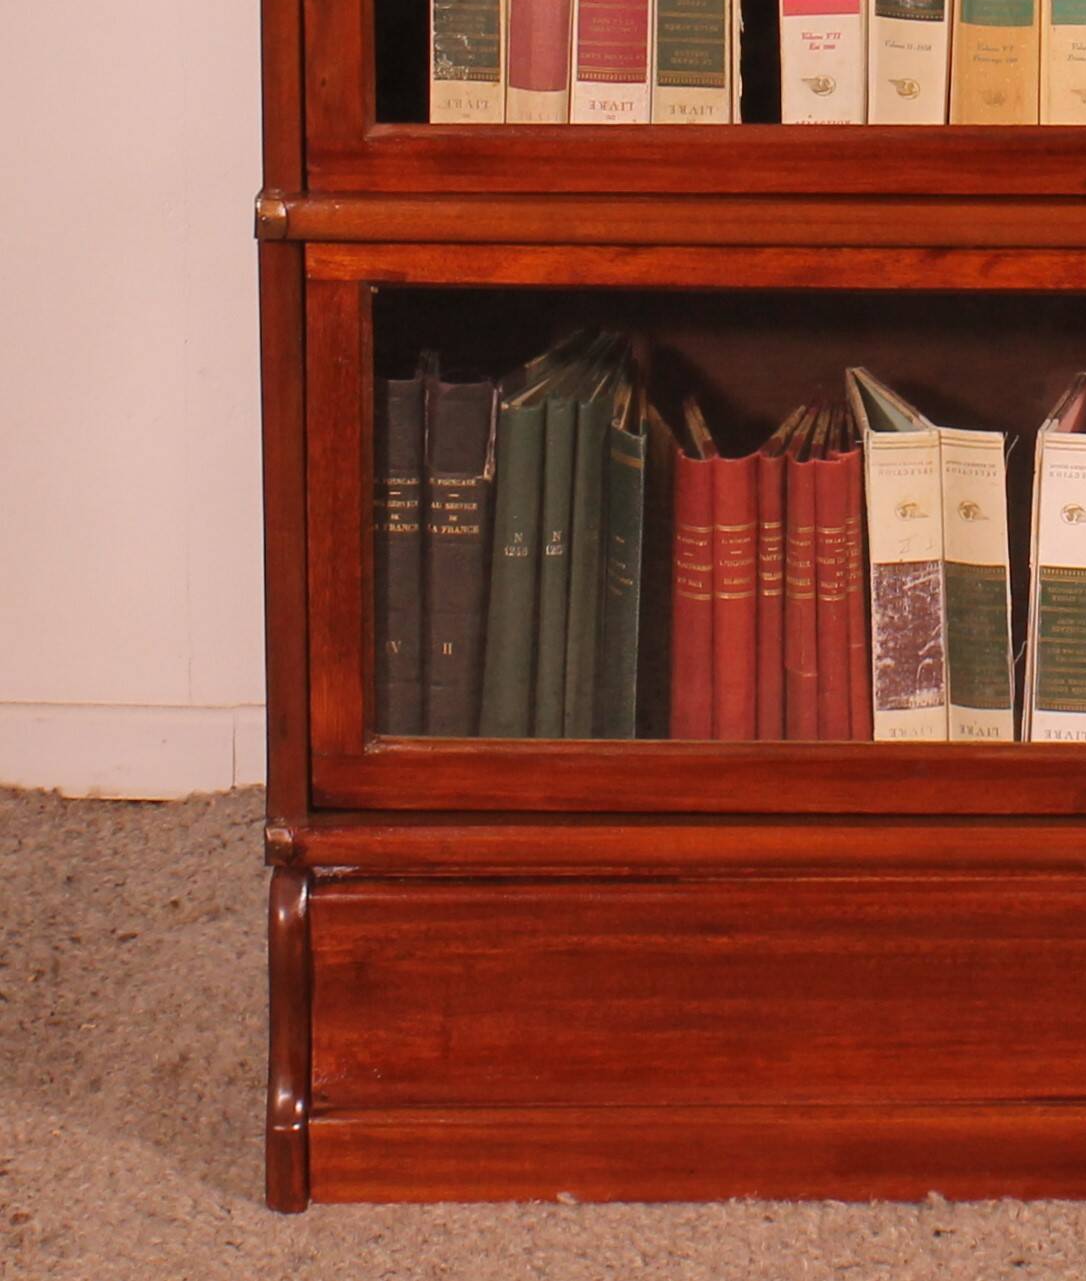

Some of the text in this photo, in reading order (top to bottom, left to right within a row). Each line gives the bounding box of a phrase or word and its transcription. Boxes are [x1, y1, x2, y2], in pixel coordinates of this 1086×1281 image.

[589, 101, 634, 112] LIVRE
[668, 105, 713, 117] LIVRE
[441, 524, 480, 535] FRANCE
[959, 725, 1001, 738] LIVRE
